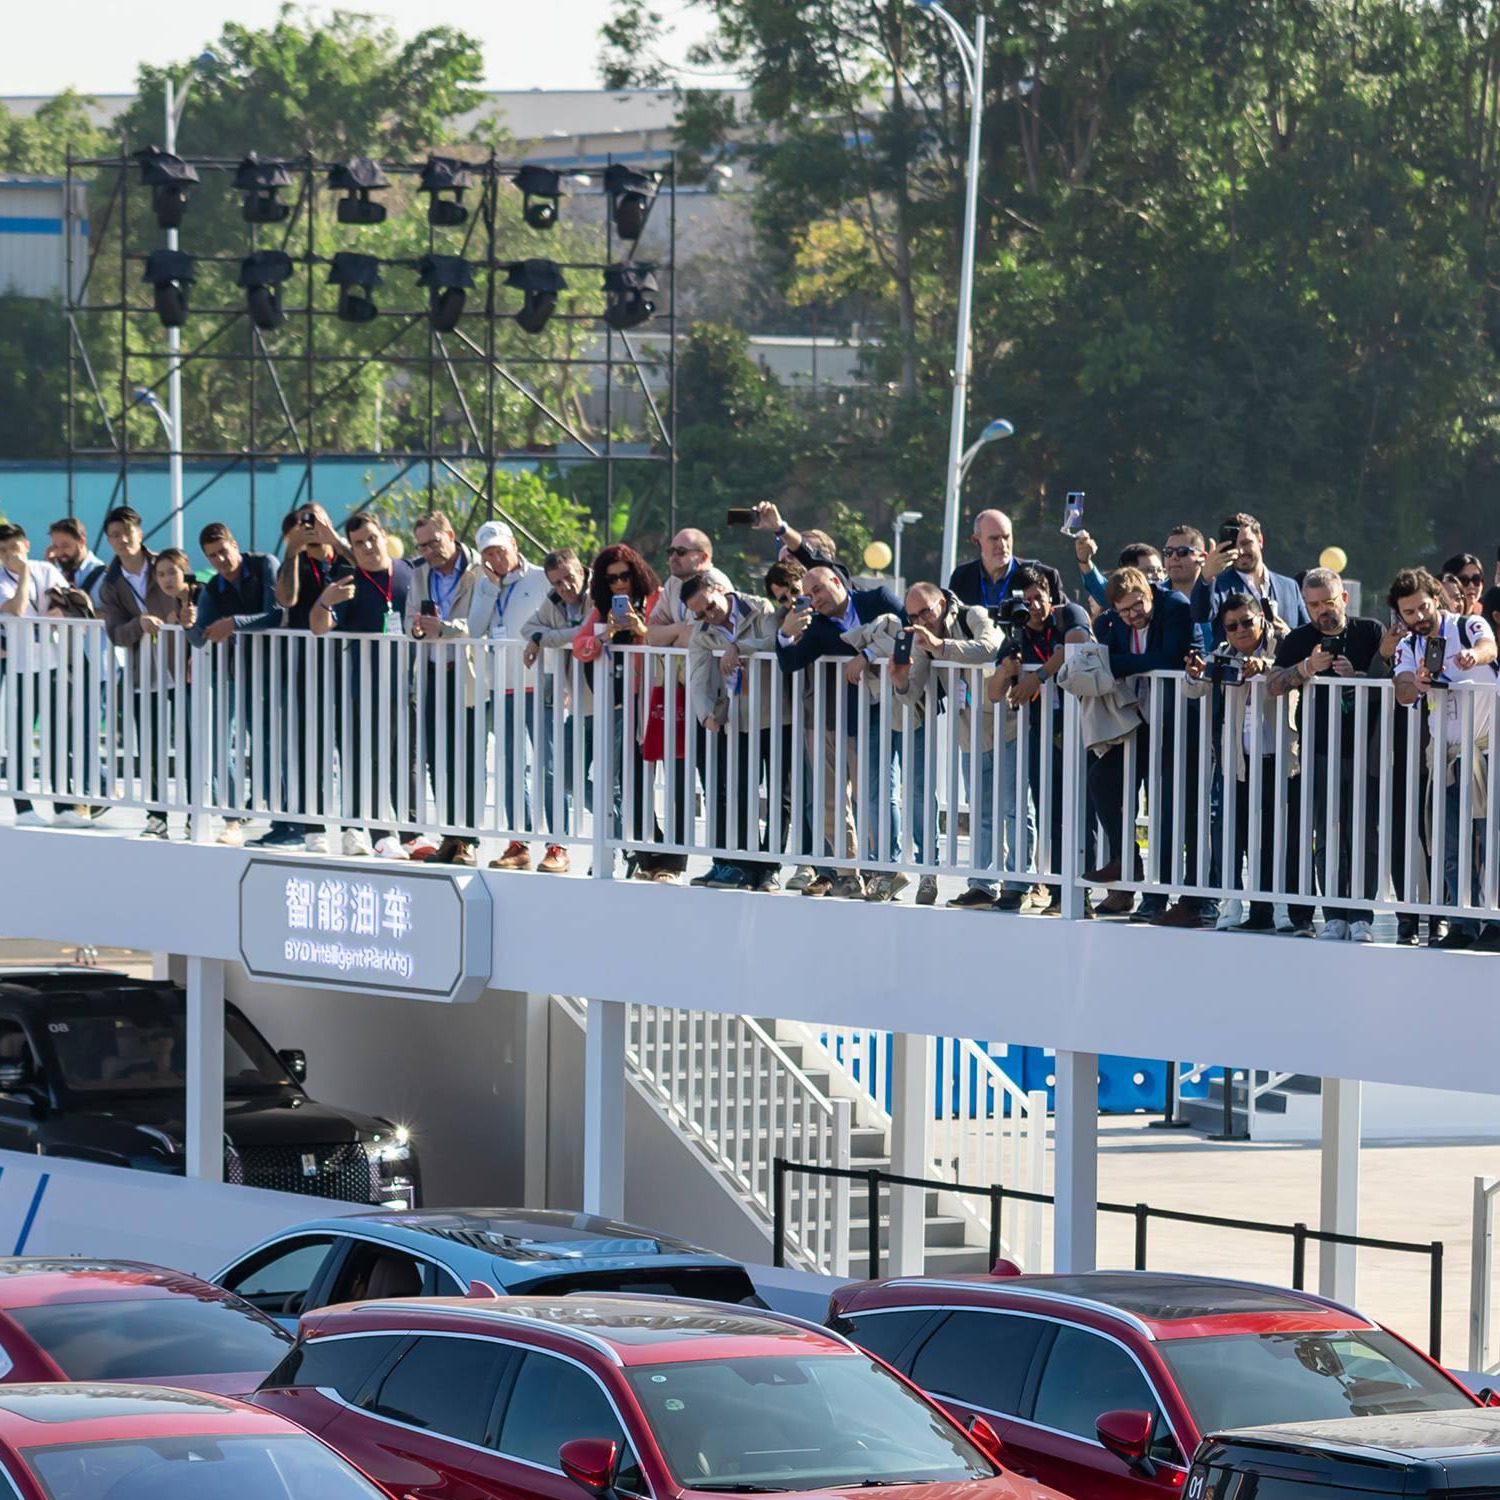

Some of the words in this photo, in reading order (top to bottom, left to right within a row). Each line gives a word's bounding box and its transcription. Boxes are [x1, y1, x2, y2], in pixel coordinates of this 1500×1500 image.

[285, 878, 412, 939] 智能泊车
[284, 940, 310, 961] BYD
[311, 942, 364, 970] Intelligent
[364, 946, 412, 979] Parking
[1188, 1475, 1204, 1500] 01
